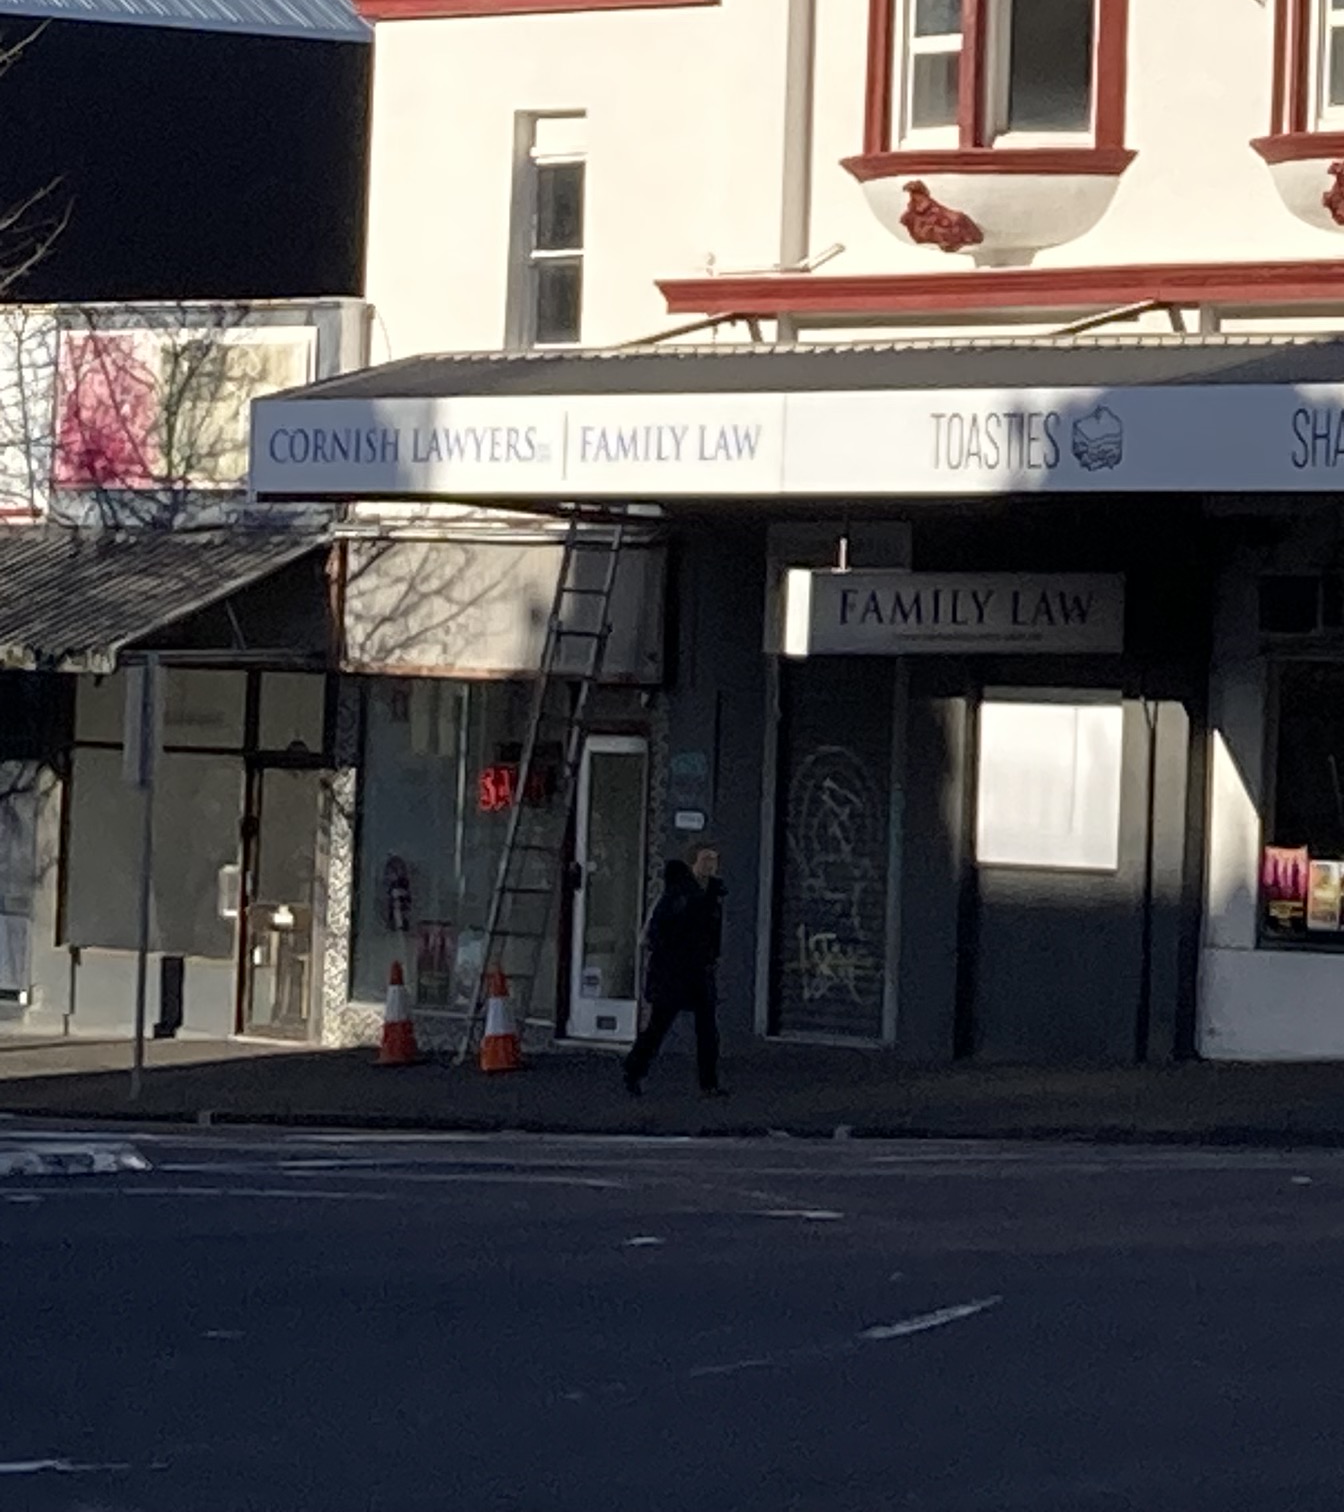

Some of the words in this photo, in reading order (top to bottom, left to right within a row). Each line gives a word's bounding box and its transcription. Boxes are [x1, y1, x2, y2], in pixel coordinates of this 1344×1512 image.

[268, 426, 400, 465] CORNISH
[411, 425, 539, 463] LAWYERS
[579, 424, 690, 462] FAMILY
[697, 423, 763, 461] LAW
[930, 411, 1062, 471] TOASTIES
[838, 588, 994, 626] FAMILY
[1010, 589, 1097, 627] LAW
